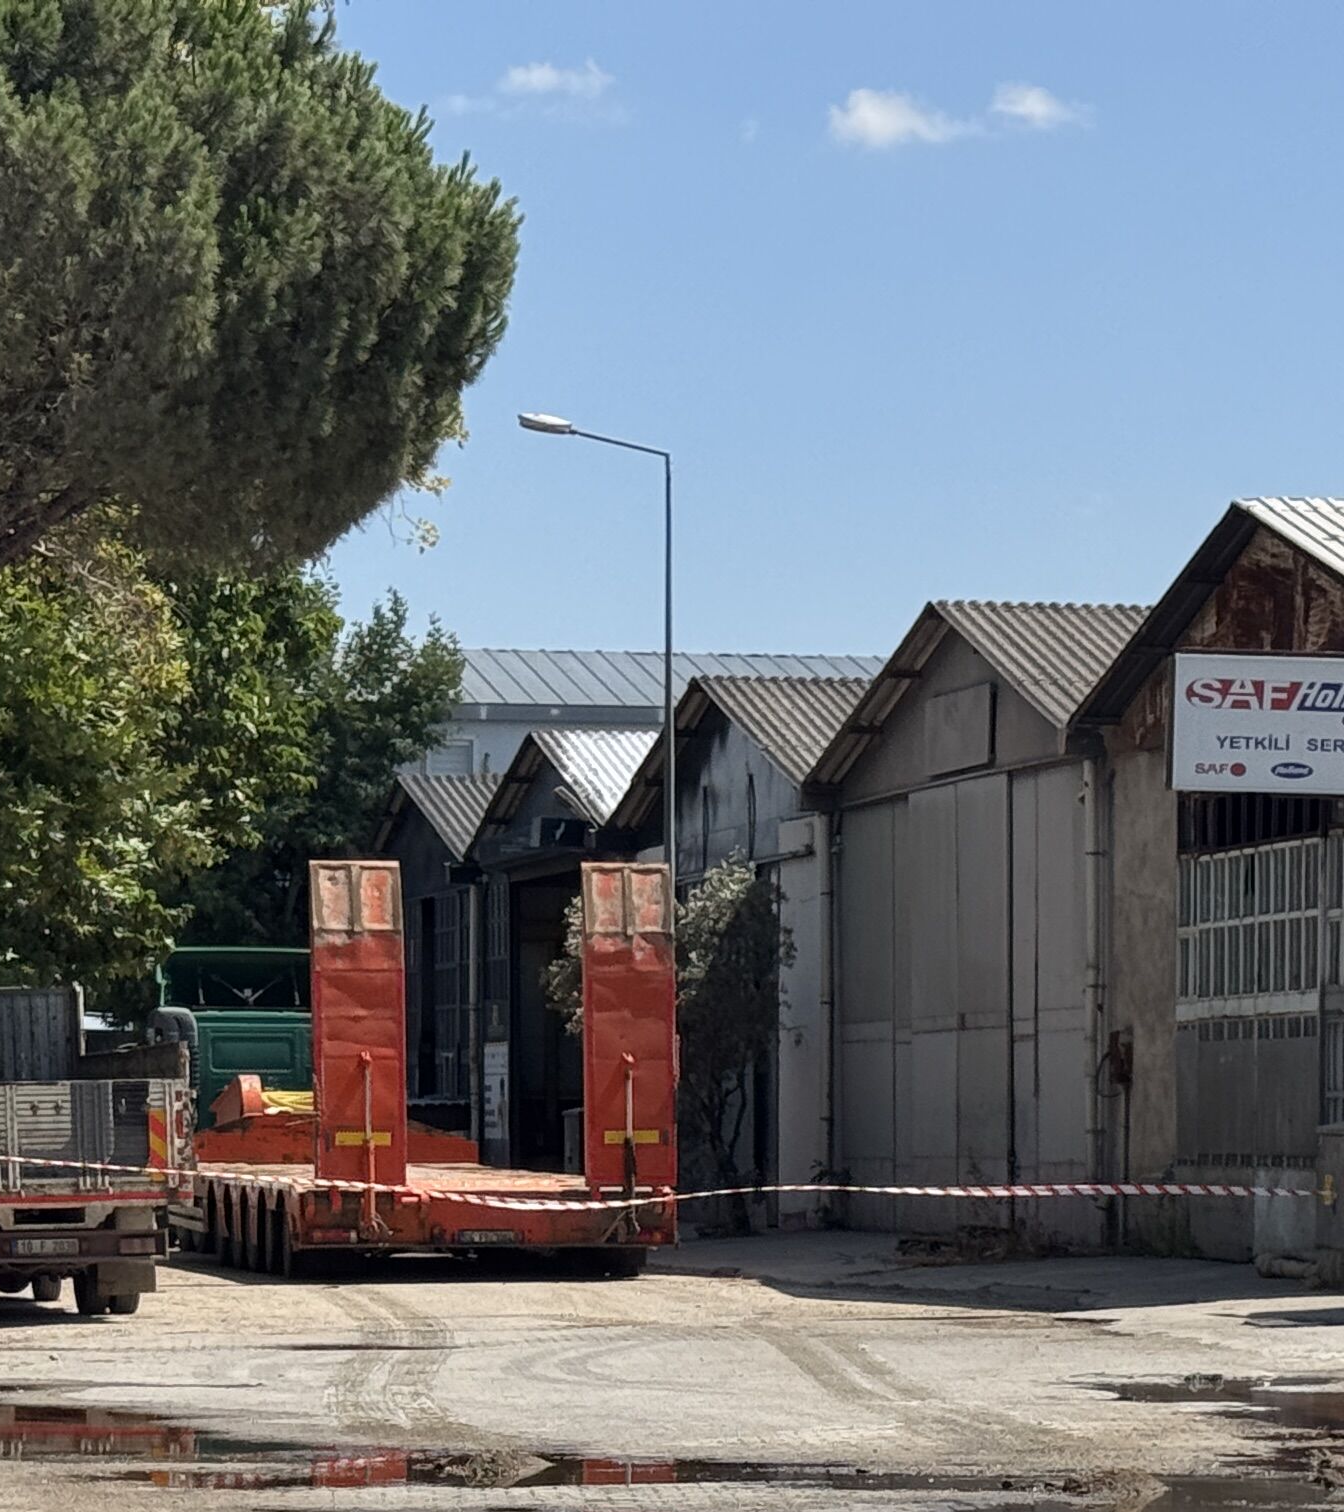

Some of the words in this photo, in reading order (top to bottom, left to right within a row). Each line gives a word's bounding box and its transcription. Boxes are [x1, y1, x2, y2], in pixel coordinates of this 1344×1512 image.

[1189, 678, 1293, 710] SAF
[1216, 734, 1291, 751] YETKİLİ
[1194, 762, 1230, 775] SAF
